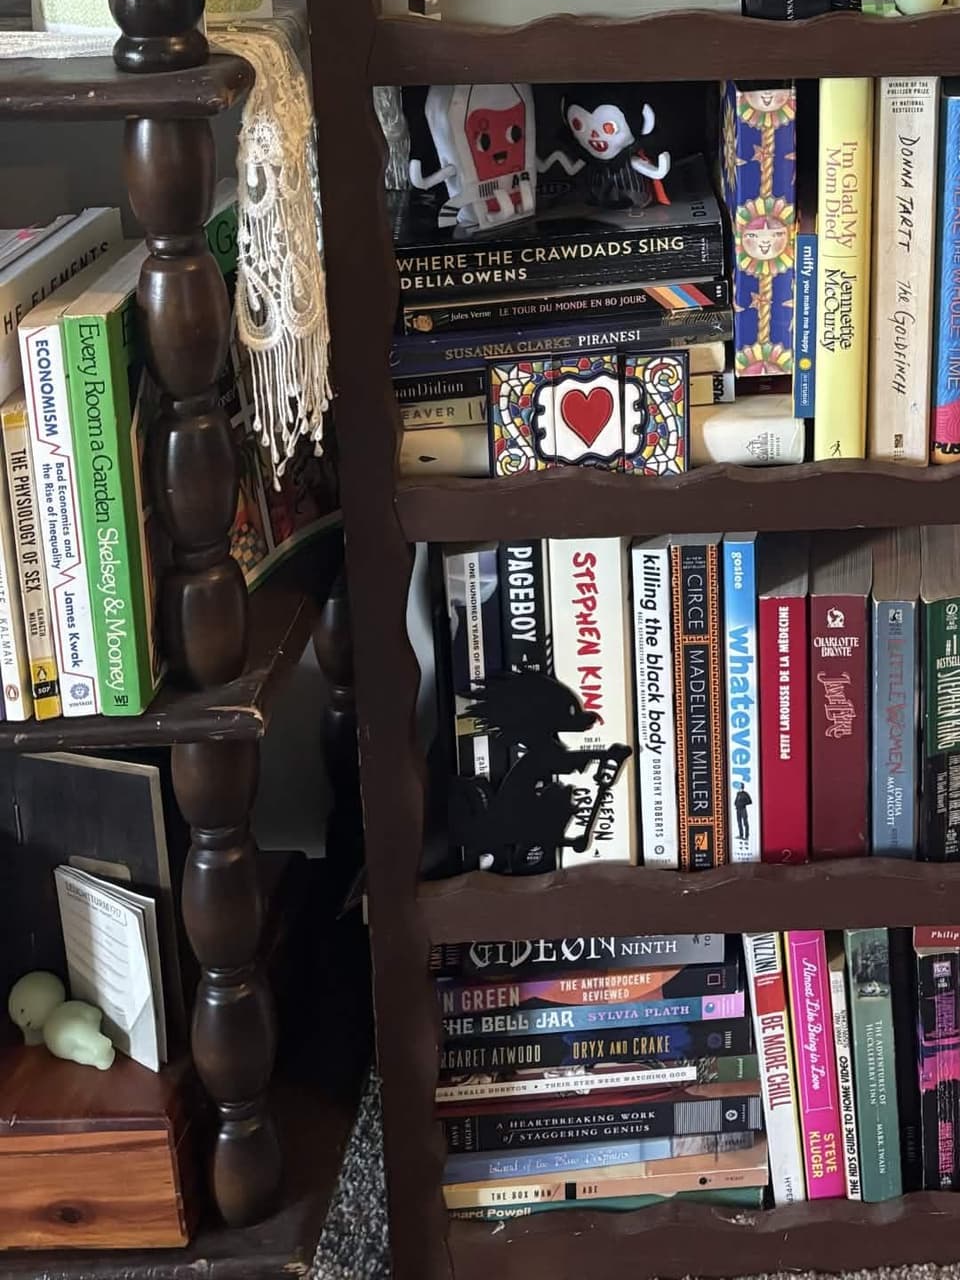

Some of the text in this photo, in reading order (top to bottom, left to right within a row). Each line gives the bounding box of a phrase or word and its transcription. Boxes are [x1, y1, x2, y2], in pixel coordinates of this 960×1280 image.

[396, 236, 685, 274] WHERE THE CRAWDADS SING
[400, 268, 528, 290] DELIA OWENS
[78, 322, 102, 376] Every
[445, 337, 572, 361] SUSANNA CLARKE
[578, 329, 641, 346] PIRANESI
[35, 339, 59, 439] ECONOMISM
[83, 381, 105, 430] Room
[88, 452, 114, 523] Garden
[506, 546, 537, 642] PAGEBOY
[640, 554, 661, 611] killing
[686, 573, 704, 631] CIRCE
[63, 591, 81, 668] James Kwak
[96, 527, 127, 692] Skelsey & Mooney
[644, 615, 657, 647] the
[645, 653, 664, 703] black
[645, 709, 665, 756] body
[689, 649, 708, 812] MADELINE MILLER
[621, 941, 677, 955] NINTH
[462, 986, 520, 1009] GREEN
[582, 989, 630, 1002] REVIEWED
[588, 1005, 690, 1022] SYLVIA PLATH
[808, 1131, 824, 1178] KLUGER
[824, 1133, 838, 1173] STEVE
